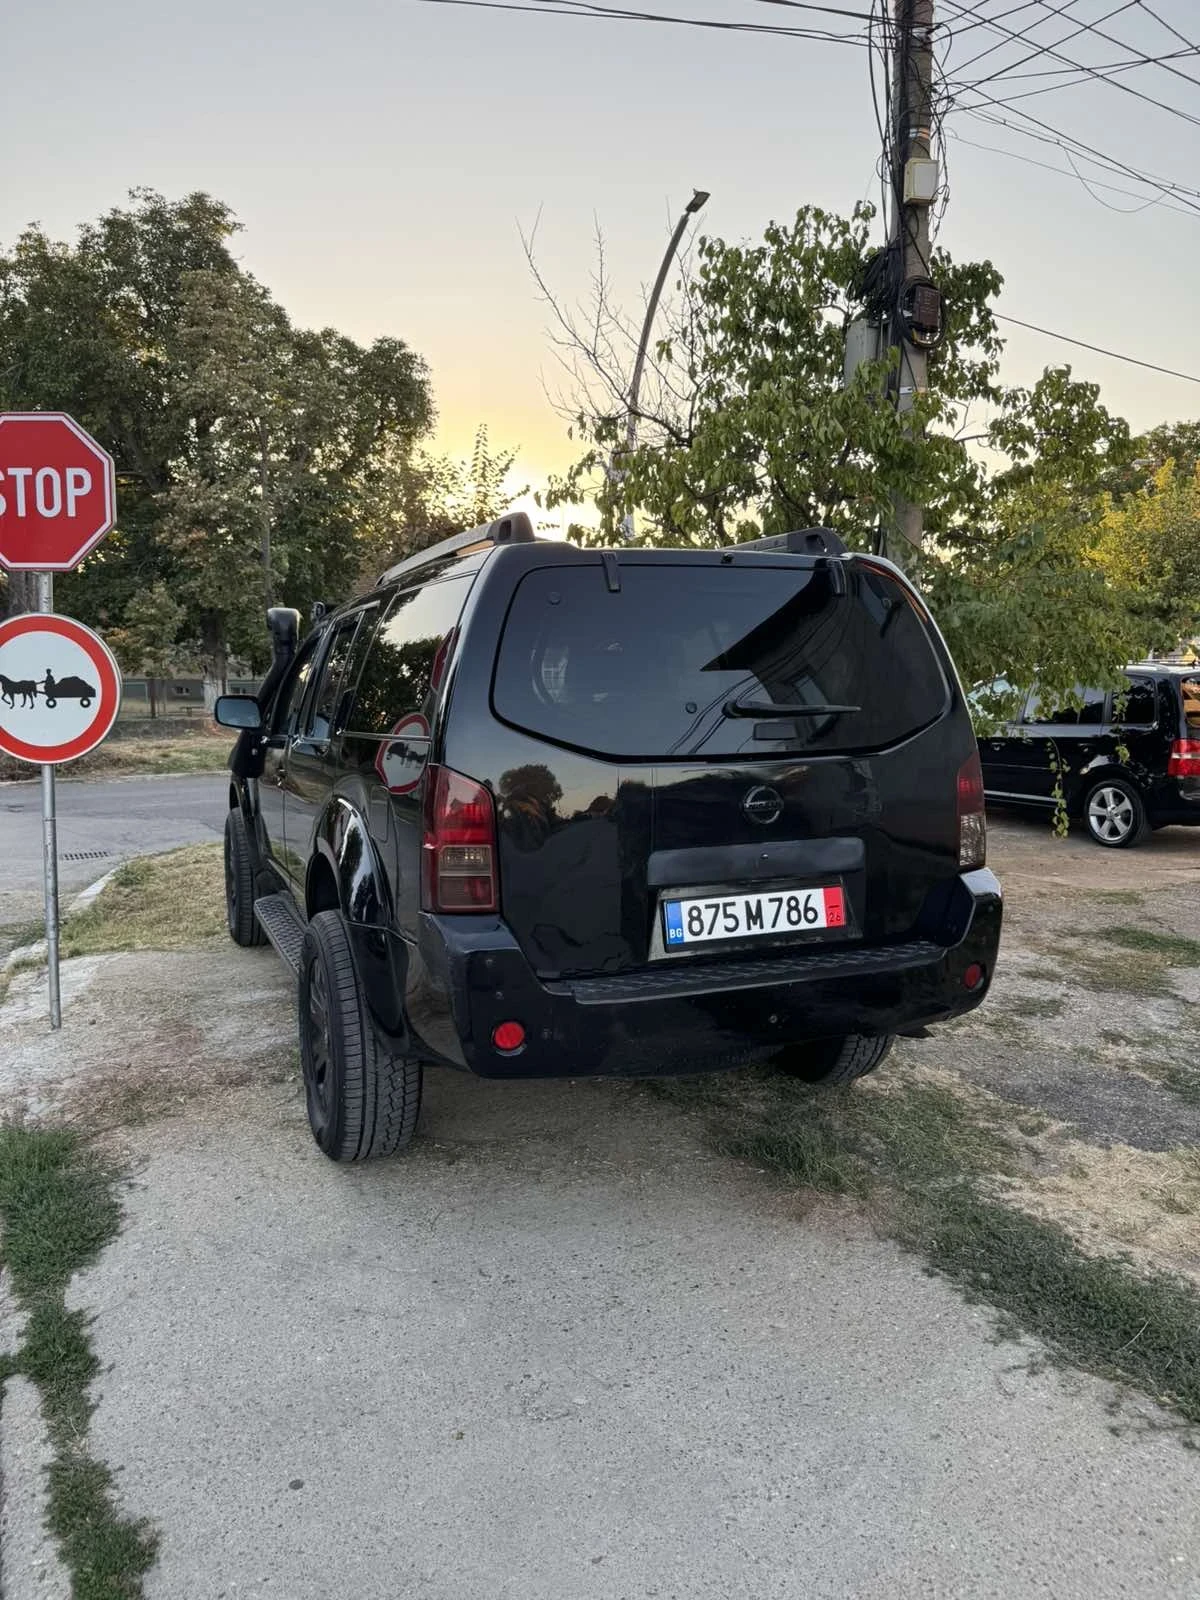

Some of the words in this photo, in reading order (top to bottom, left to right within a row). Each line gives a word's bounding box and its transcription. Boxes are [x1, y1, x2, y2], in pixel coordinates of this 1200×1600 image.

[0, 467, 92, 518] TOP
[829, 911, 842, 923] 26
[669, 928, 682, 938] BG
